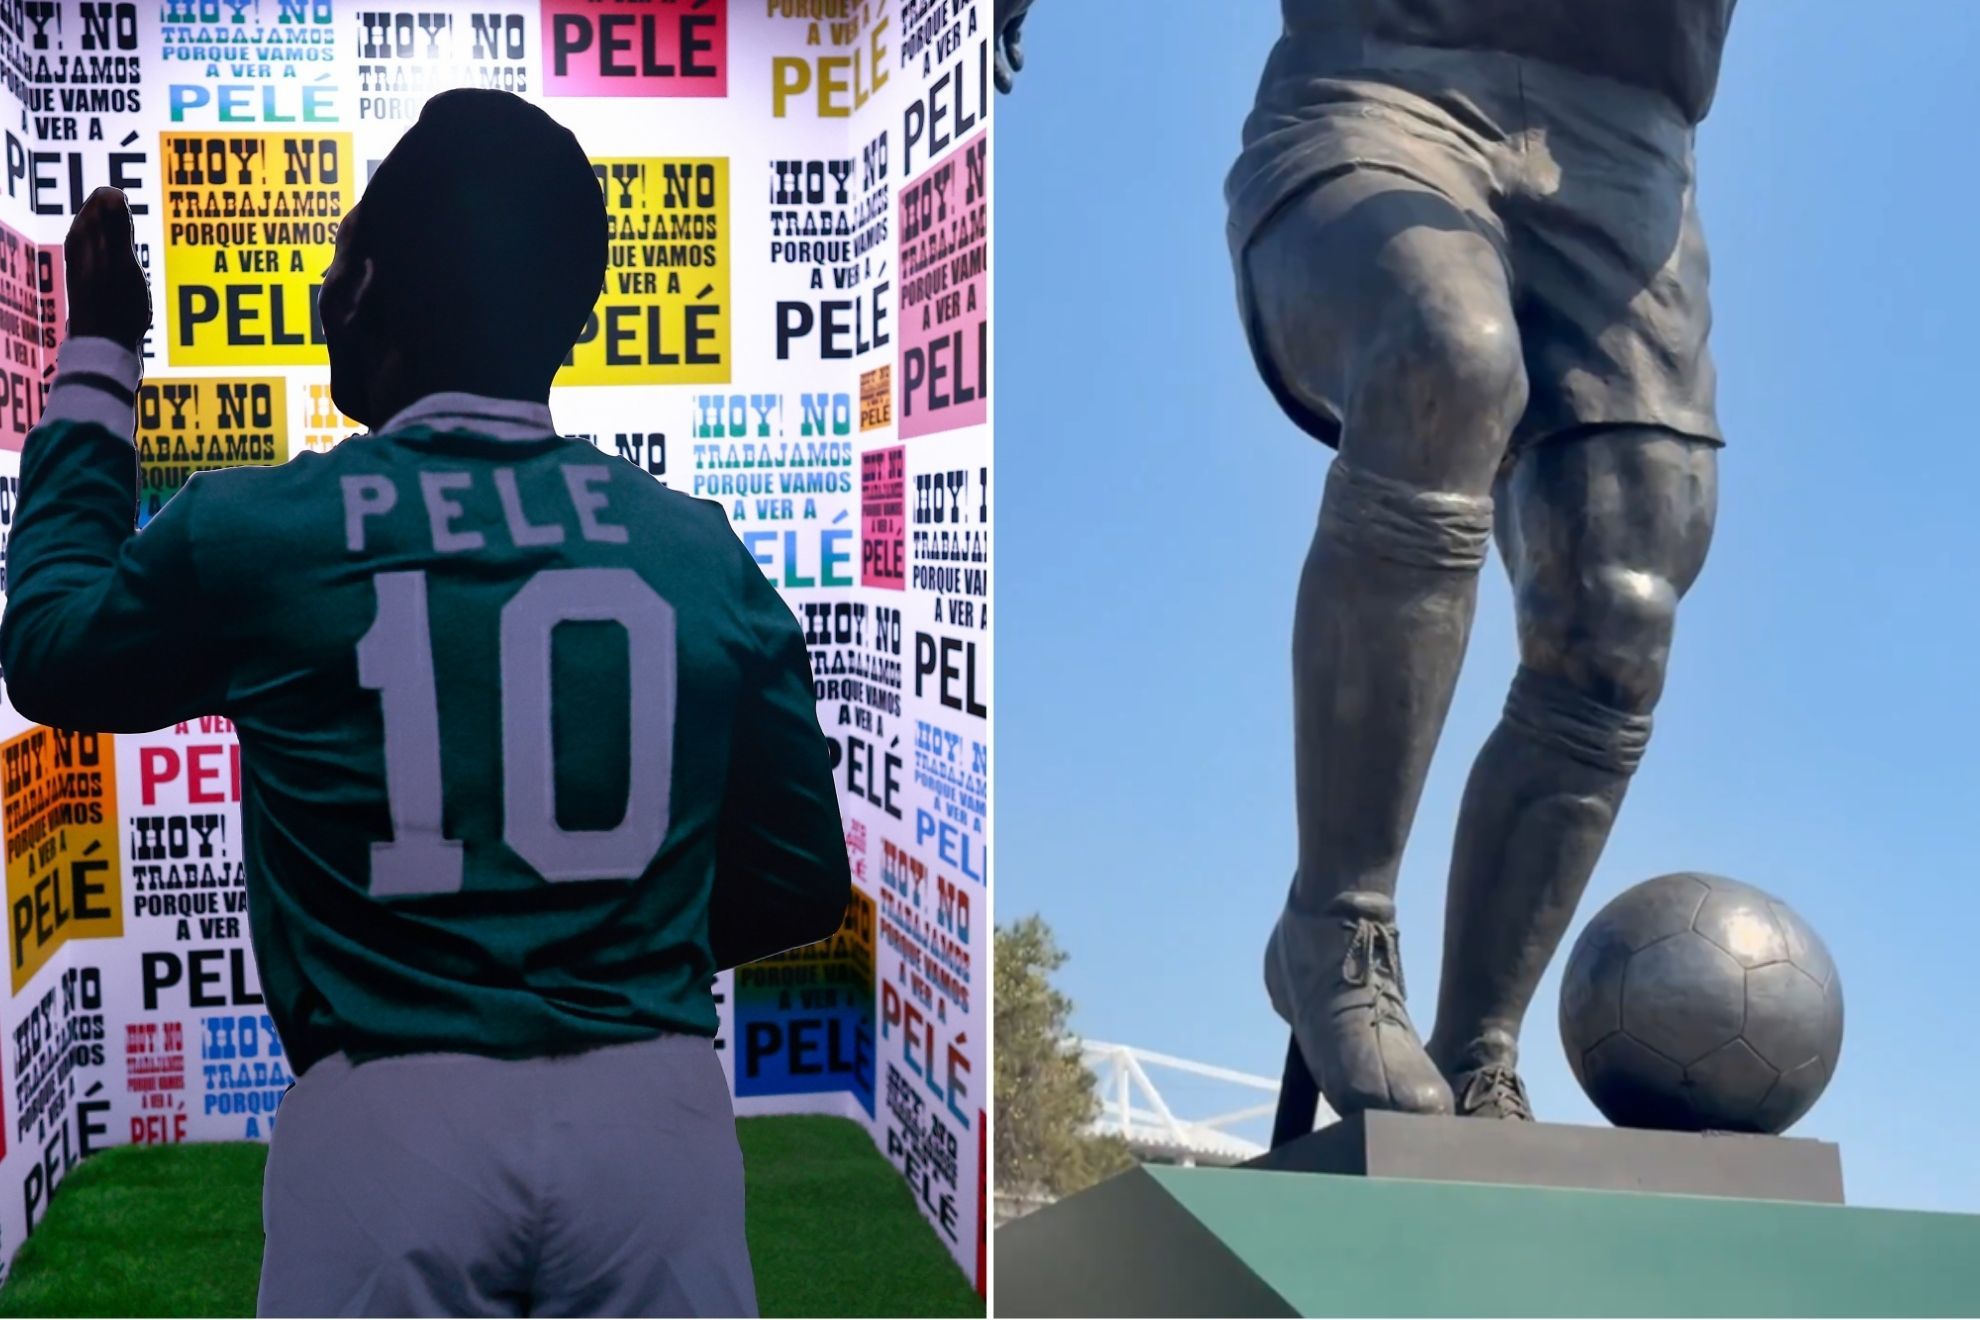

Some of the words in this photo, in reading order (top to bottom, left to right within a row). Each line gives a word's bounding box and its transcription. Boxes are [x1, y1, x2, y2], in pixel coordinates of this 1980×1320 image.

[81, 2, 138, 50] NO
[278, 0, 333, 24] NO
[807, 22, 820, 44] A
[161, 27, 334, 44] TRABAJAMOS
[162, 46, 249, 62] PORQUE
[256, 47, 334, 61] VAMOS
[471, 13, 525, 59] NO
[553, 0, 717, 77] PELÉ
[923, 50, 930, 78] A
[968, 6, 977, 37] A
[206, 64, 219, 77] A
[231, 64, 271, 77] VER
[284, 64, 296, 77] A
[773, 0, 889, 118] PELÉ
[60, 88, 141, 113] VAMOS
[169, 73, 339, 122] PELÉ
[34, 117, 77, 140] VER
[89, 118, 103, 140] A
[168, 138, 266, 185] ¡HOY!
[284, 139, 338, 184] NO
[170, 191, 341, 218] TRABAJAMOS
[663, 163, 715, 208] NO
[171, 223, 257, 248] PORQUE
[263, 223, 340, 245] VAMOS
[642, 245, 716, 267] VAMOS
[771, 241, 850, 265] PORQUE
[901, 204, 986, 280] TRABAJAM
[214, 251, 228, 272] A
[238, 251, 279, 272] VER
[290, 251, 304, 272] A
[811, 268, 823, 289] A
[618, 272, 657, 294] VER
[667, 272, 681, 294] A
[901, 264, 947, 311] PORQUE
[777, 260, 890, 359] PELÉ
[922, 304, 932, 331] A
[936, 291, 960, 324] VER
[967, 284, 976, 312] A
[217, 383, 272, 429] NO
[801, 393, 851, 437] NO
[140, 435, 276, 462] ABAJAMOS
[615, 433, 666, 476] NO
[693, 442, 853, 469] TRABAJAMOS
[694, 472, 774, 497] PORQUE
[779, 472, 851, 494] VAMOS
[340, 464, 629, 552] PELE
[733, 500, 746, 521] A
[756, 499, 793, 520] VER
[804, 498, 817, 519] A
[743, 510, 853, 588] ELÉ
[914, 565, 961, 595] PORQUE
[876, 606, 902, 656] NO
[935, 598, 943, 622] A
[949, 599, 973, 627] VER
[814, 679, 863, 704] ORQUE
[915, 630, 986, 720] PEL
[355, 567, 676, 897] 10
[839, 704, 850, 725] A
[855, 706, 873, 733] VER
[877, 715, 884, 738] A
[53, 727, 99, 769] NO
[934, 796, 941, 812] A
[946, 803, 968, 826] VER
[973, 817, 981, 833] A
[28, 853, 36, 878] A
[60, 828, 67, 852] A
[131, 814, 226, 861] ¡HOY!
[917, 808, 986, 888] PEL
[133, 862, 246, 892] TRABAJA
[14, 839, 111, 970] PELÉ
[134, 892, 219, 917] PORQUE
[937, 874, 969, 944] NO
[176, 920, 191, 941] A
[200, 917, 240, 940] VER
[61, 966, 102, 1018] NO
[142, 948, 265, 1011] PEL
[746, 1017, 872, 1095] PELÉ
[882, 977, 971, 1131] PELÉ
[204, 1090, 283, 1116] PORQU
[246, 1117, 260, 1139] A
